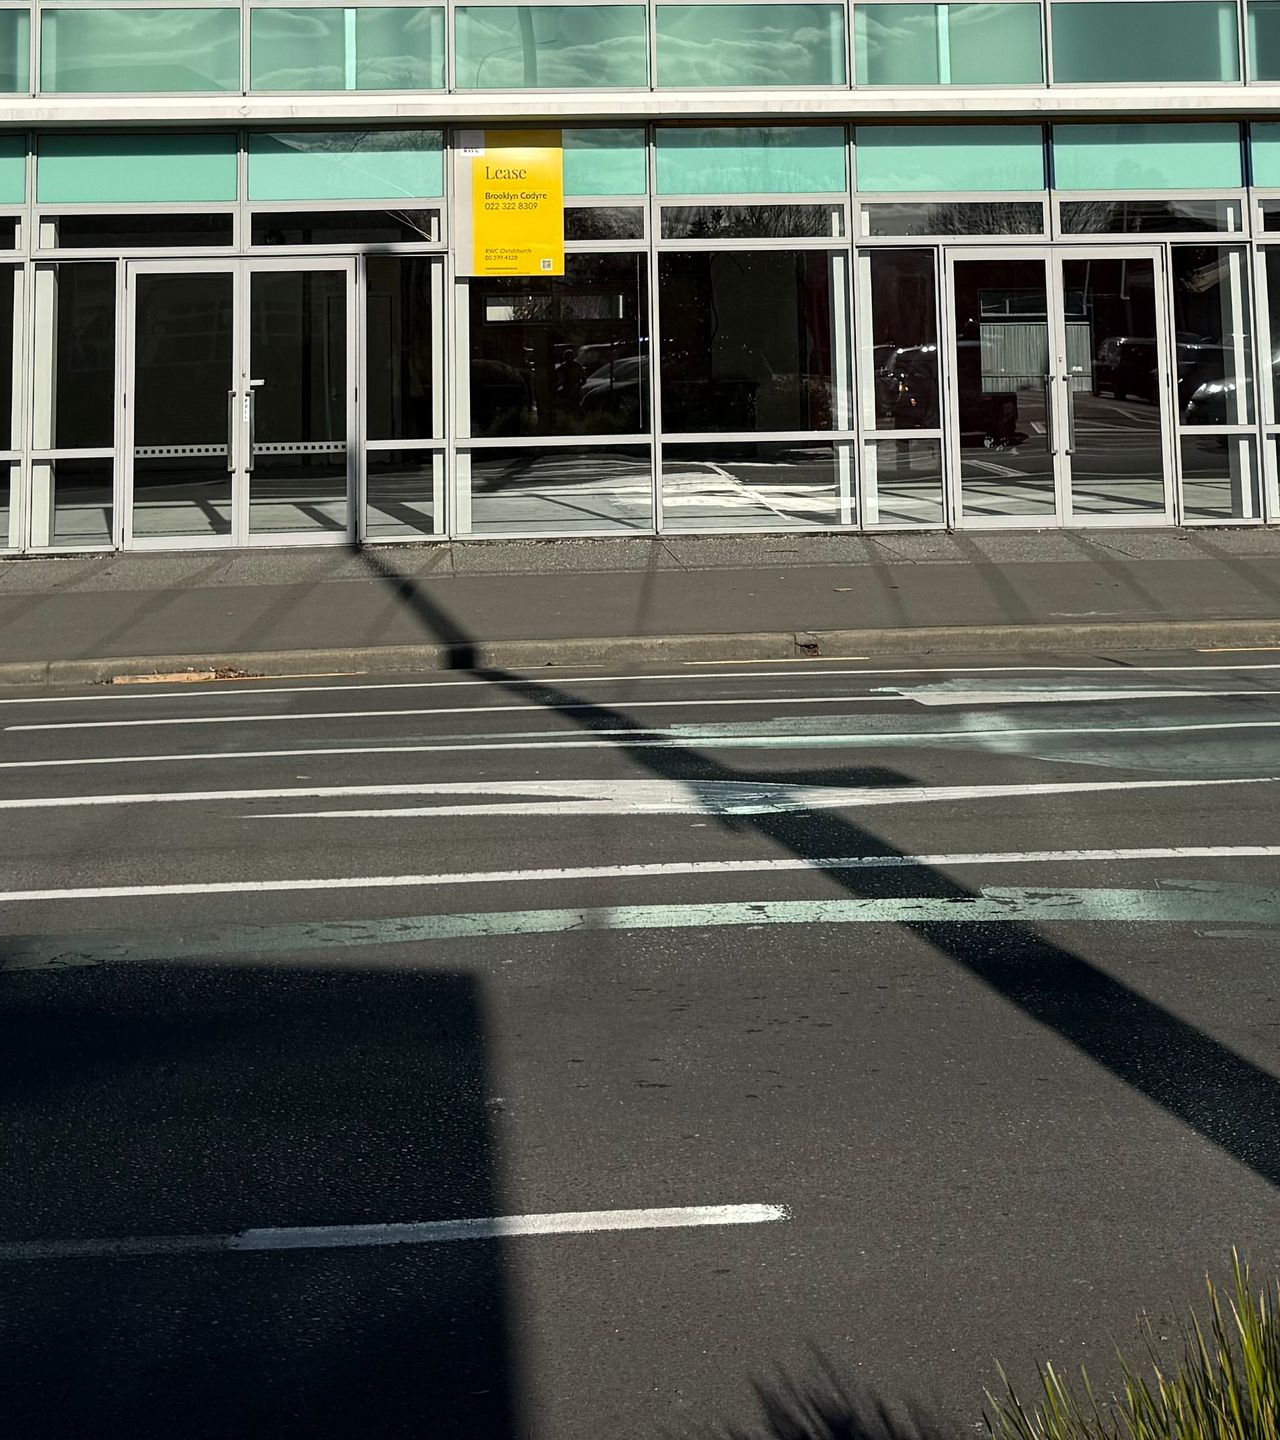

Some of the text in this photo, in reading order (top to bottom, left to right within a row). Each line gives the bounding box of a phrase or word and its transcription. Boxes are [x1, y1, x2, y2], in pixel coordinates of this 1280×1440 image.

[485, 166, 527, 180] Lease
[485, 192, 548, 201] Brooklyn Codyre
[485, 202, 538, 211] 022 322 8309
